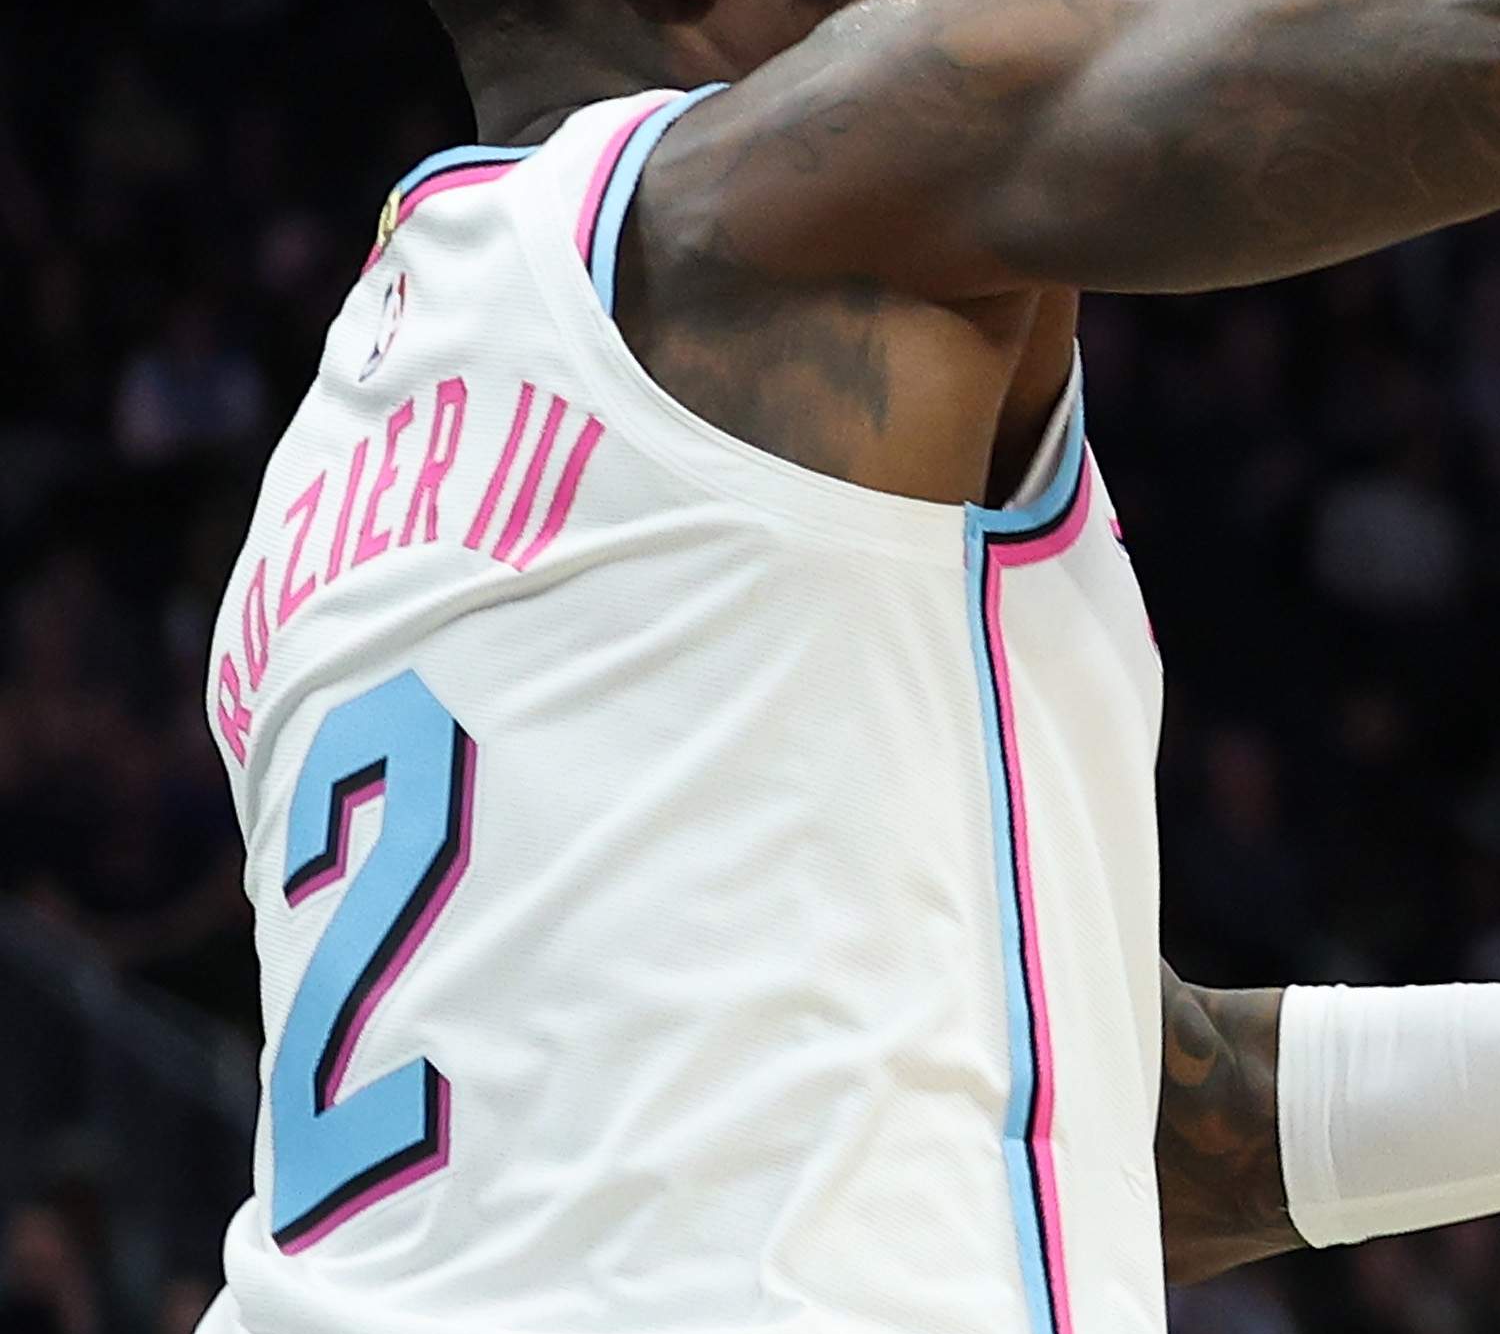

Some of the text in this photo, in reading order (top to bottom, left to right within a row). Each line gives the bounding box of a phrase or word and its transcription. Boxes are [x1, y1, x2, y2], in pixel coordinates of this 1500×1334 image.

[216, 376, 606, 768] ROZIER III
[269, 668, 478, 1257] 2
